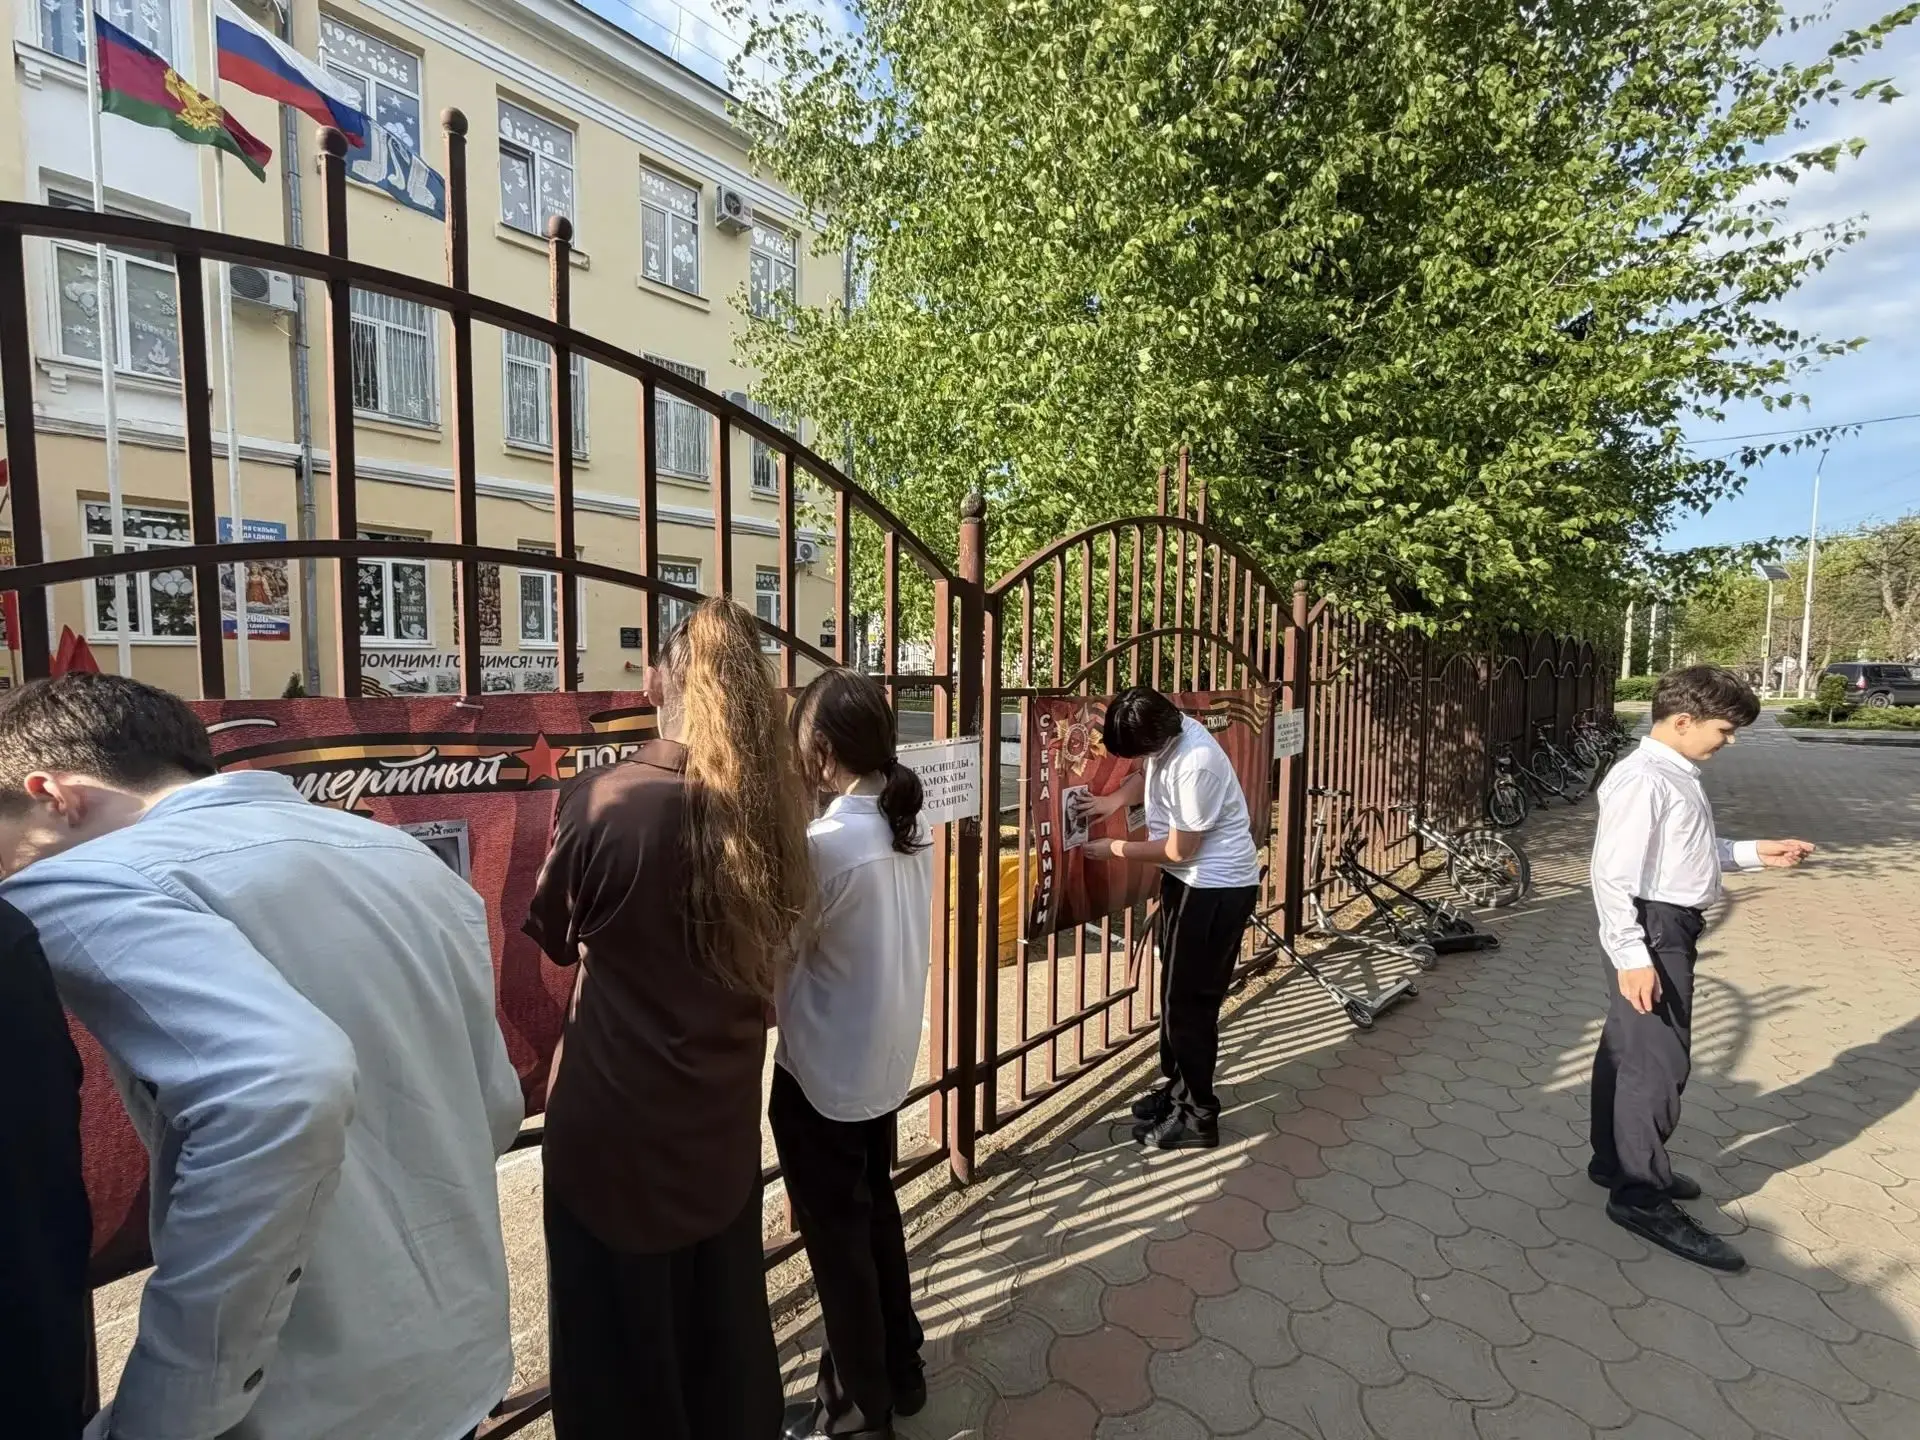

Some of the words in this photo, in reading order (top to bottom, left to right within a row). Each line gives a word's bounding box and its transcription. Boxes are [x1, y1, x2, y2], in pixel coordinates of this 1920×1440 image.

[367, 57, 408, 83] 1945
[501, 117, 513, 138] 9
[515, 128, 555, 155] МАЯ
[663, 571, 694, 583] МАЯ
[1206, 714, 1229, 728] ПОЛК
[1039, 713, 1051, 801] СТЕНА
[922, 771, 967, 788] АМОКАТЫ
[942, 782, 974, 796] БАННЕРА
[928, 793, 969, 810] СТАВИТЬ!
[1036, 821, 1053, 924] ПАМЯТИ
